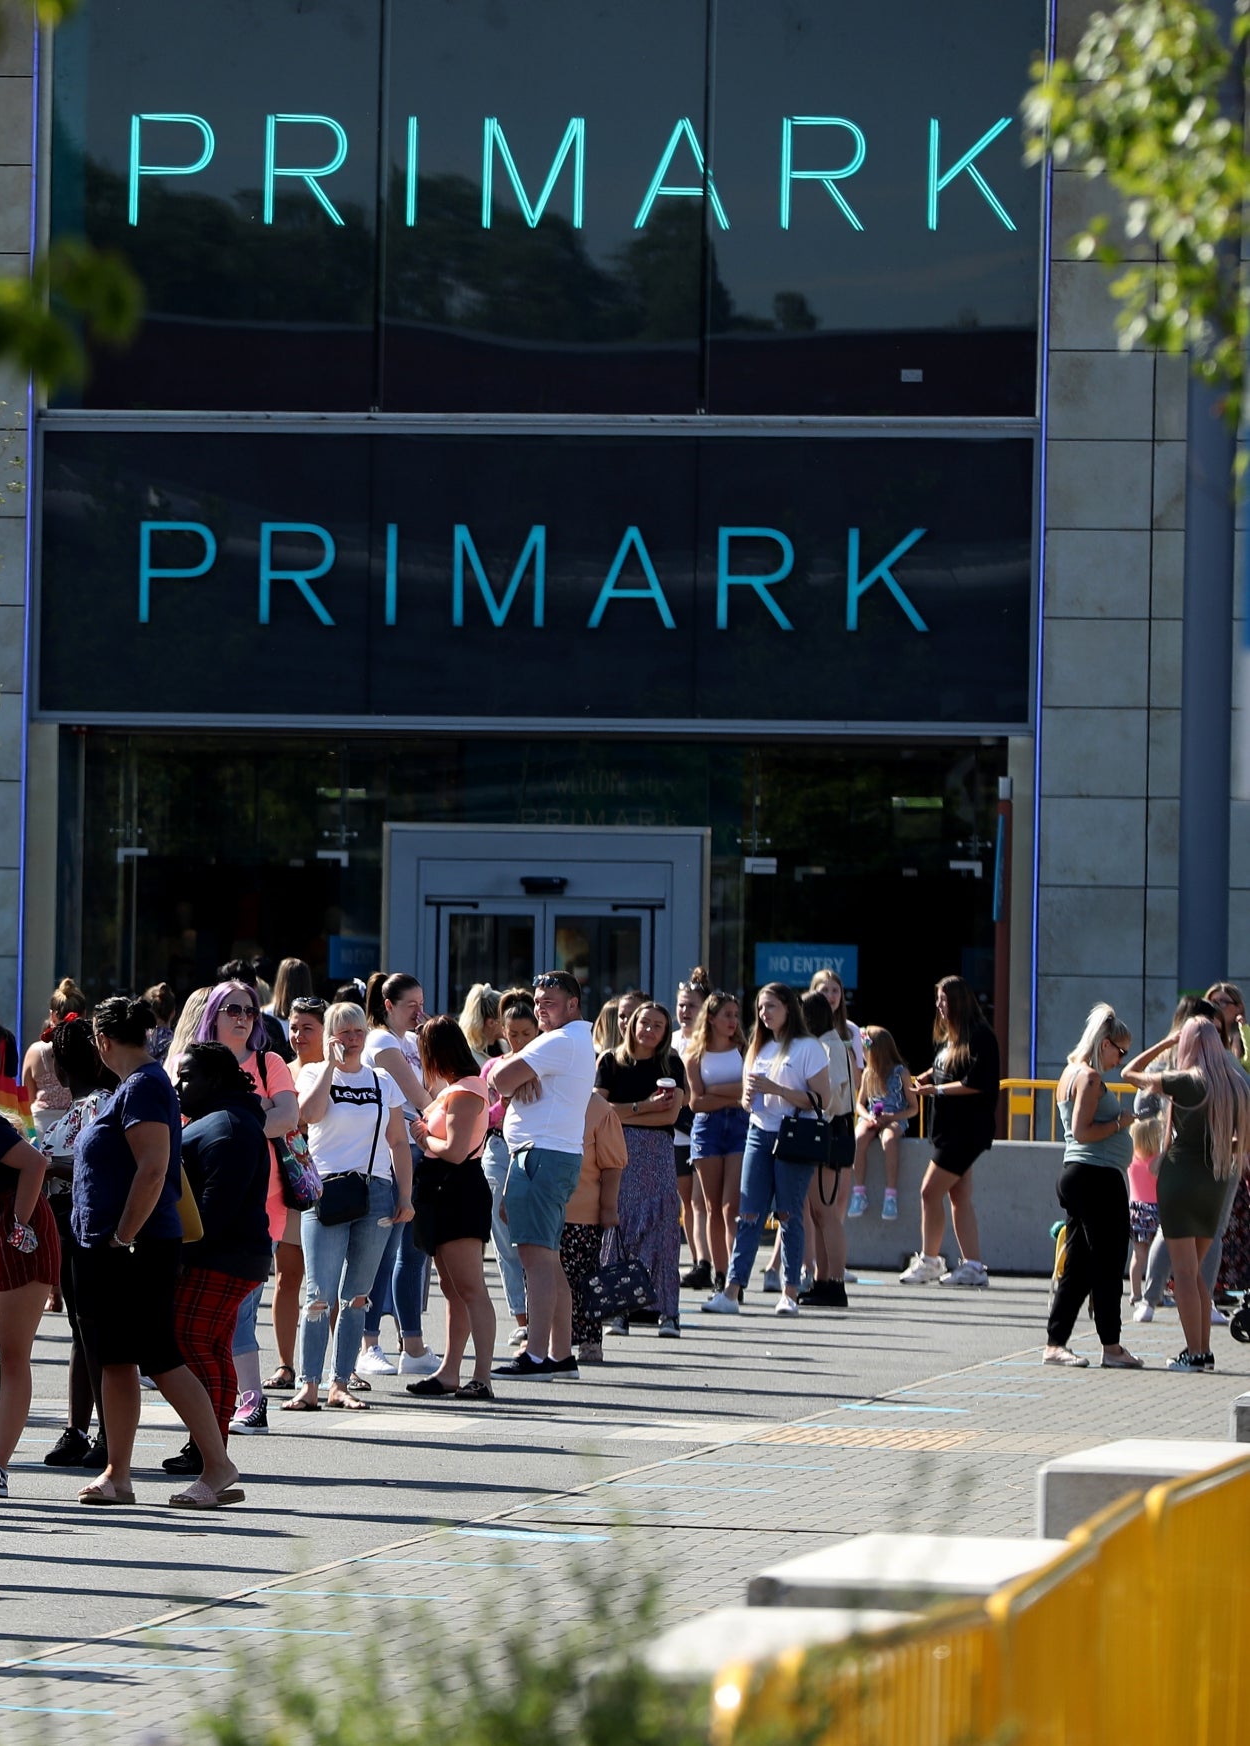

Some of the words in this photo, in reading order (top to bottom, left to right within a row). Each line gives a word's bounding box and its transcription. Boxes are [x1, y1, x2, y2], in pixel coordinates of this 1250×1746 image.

[128, 112, 1018, 232] PRIMARK
[138, 521, 930, 633] PRIMARK
[768, 955, 790, 973] NO
[793, 955, 845, 974] ENTRY
[334, 1089, 377, 1100] Levi's
